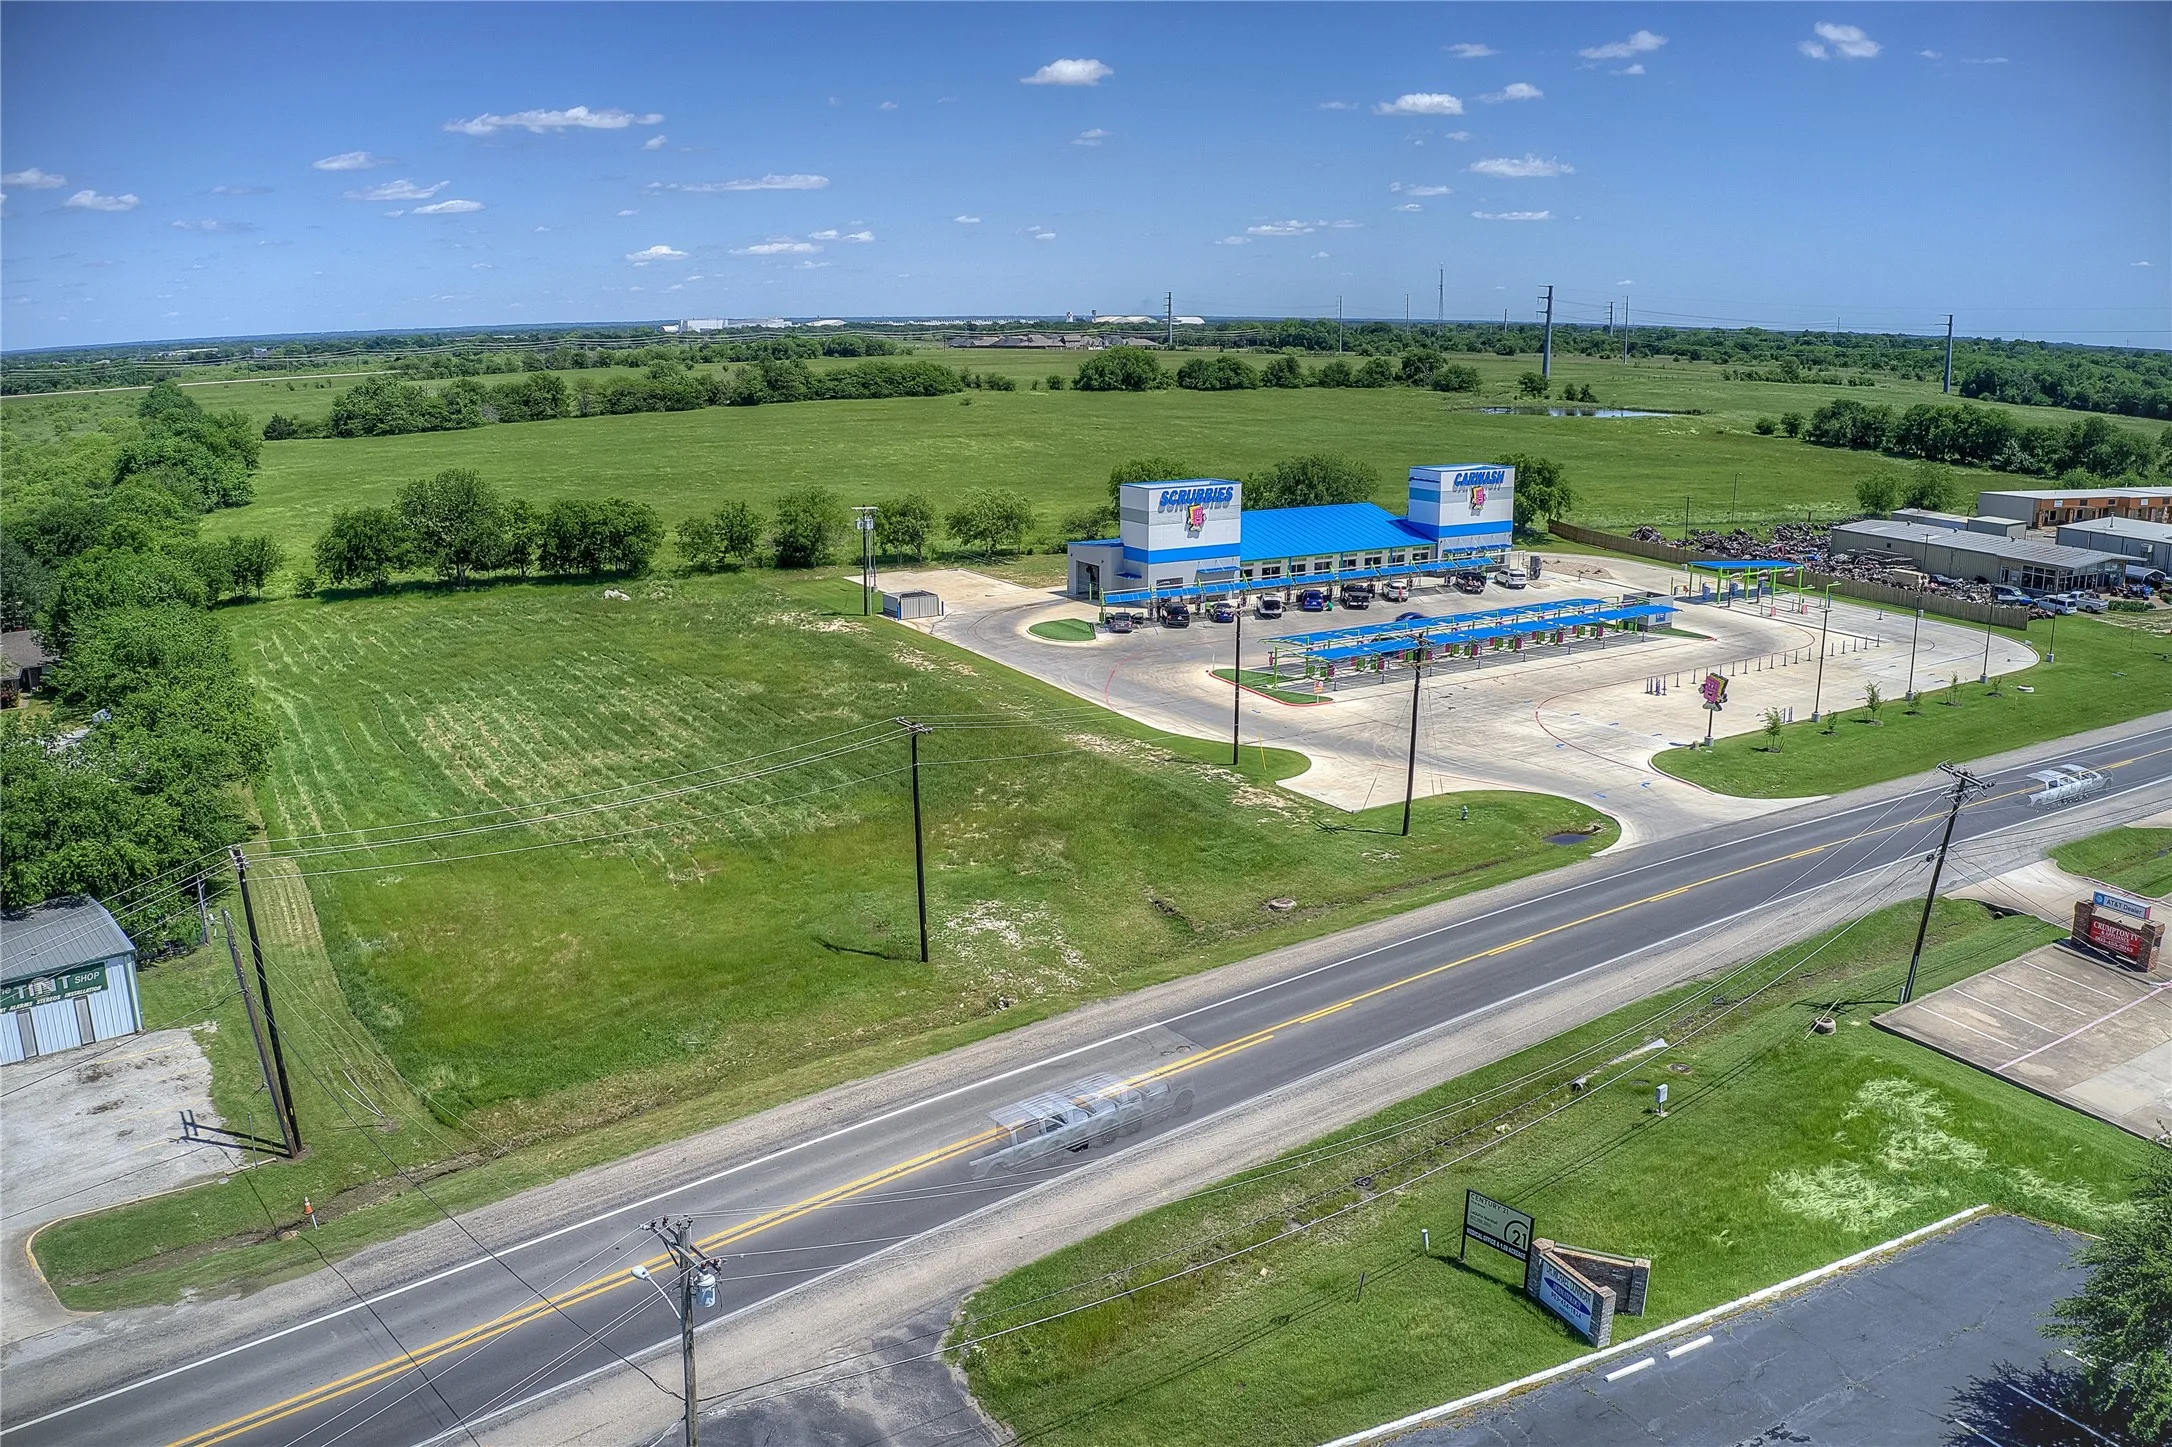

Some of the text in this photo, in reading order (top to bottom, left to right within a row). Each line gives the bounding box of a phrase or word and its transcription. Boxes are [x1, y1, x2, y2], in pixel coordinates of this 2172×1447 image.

[1454, 470, 1505, 487] CARWASH
[1159, 486, 1234, 507] SCRUBBIES
[2106, 899, 2142, 914] AT&T Dealer
[2093, 921, 2130, 938] CRUMPTON
[2130, 933, 2139, 941] TV
[14, 975, 71, 999] TINT
[74, 971, 100, 984] SHOP
[36, 994, 61, 1005] STEREOS
[64, 985, 102, 997] INSTALLATION
[1470, 1193, 1502, 1212] CENTURY
[1502, 1207, 1509, 1215] 21
[1483, 1235, 1496, 1246] OFFICE
[1512, 1229, 1527, 1249] 21
